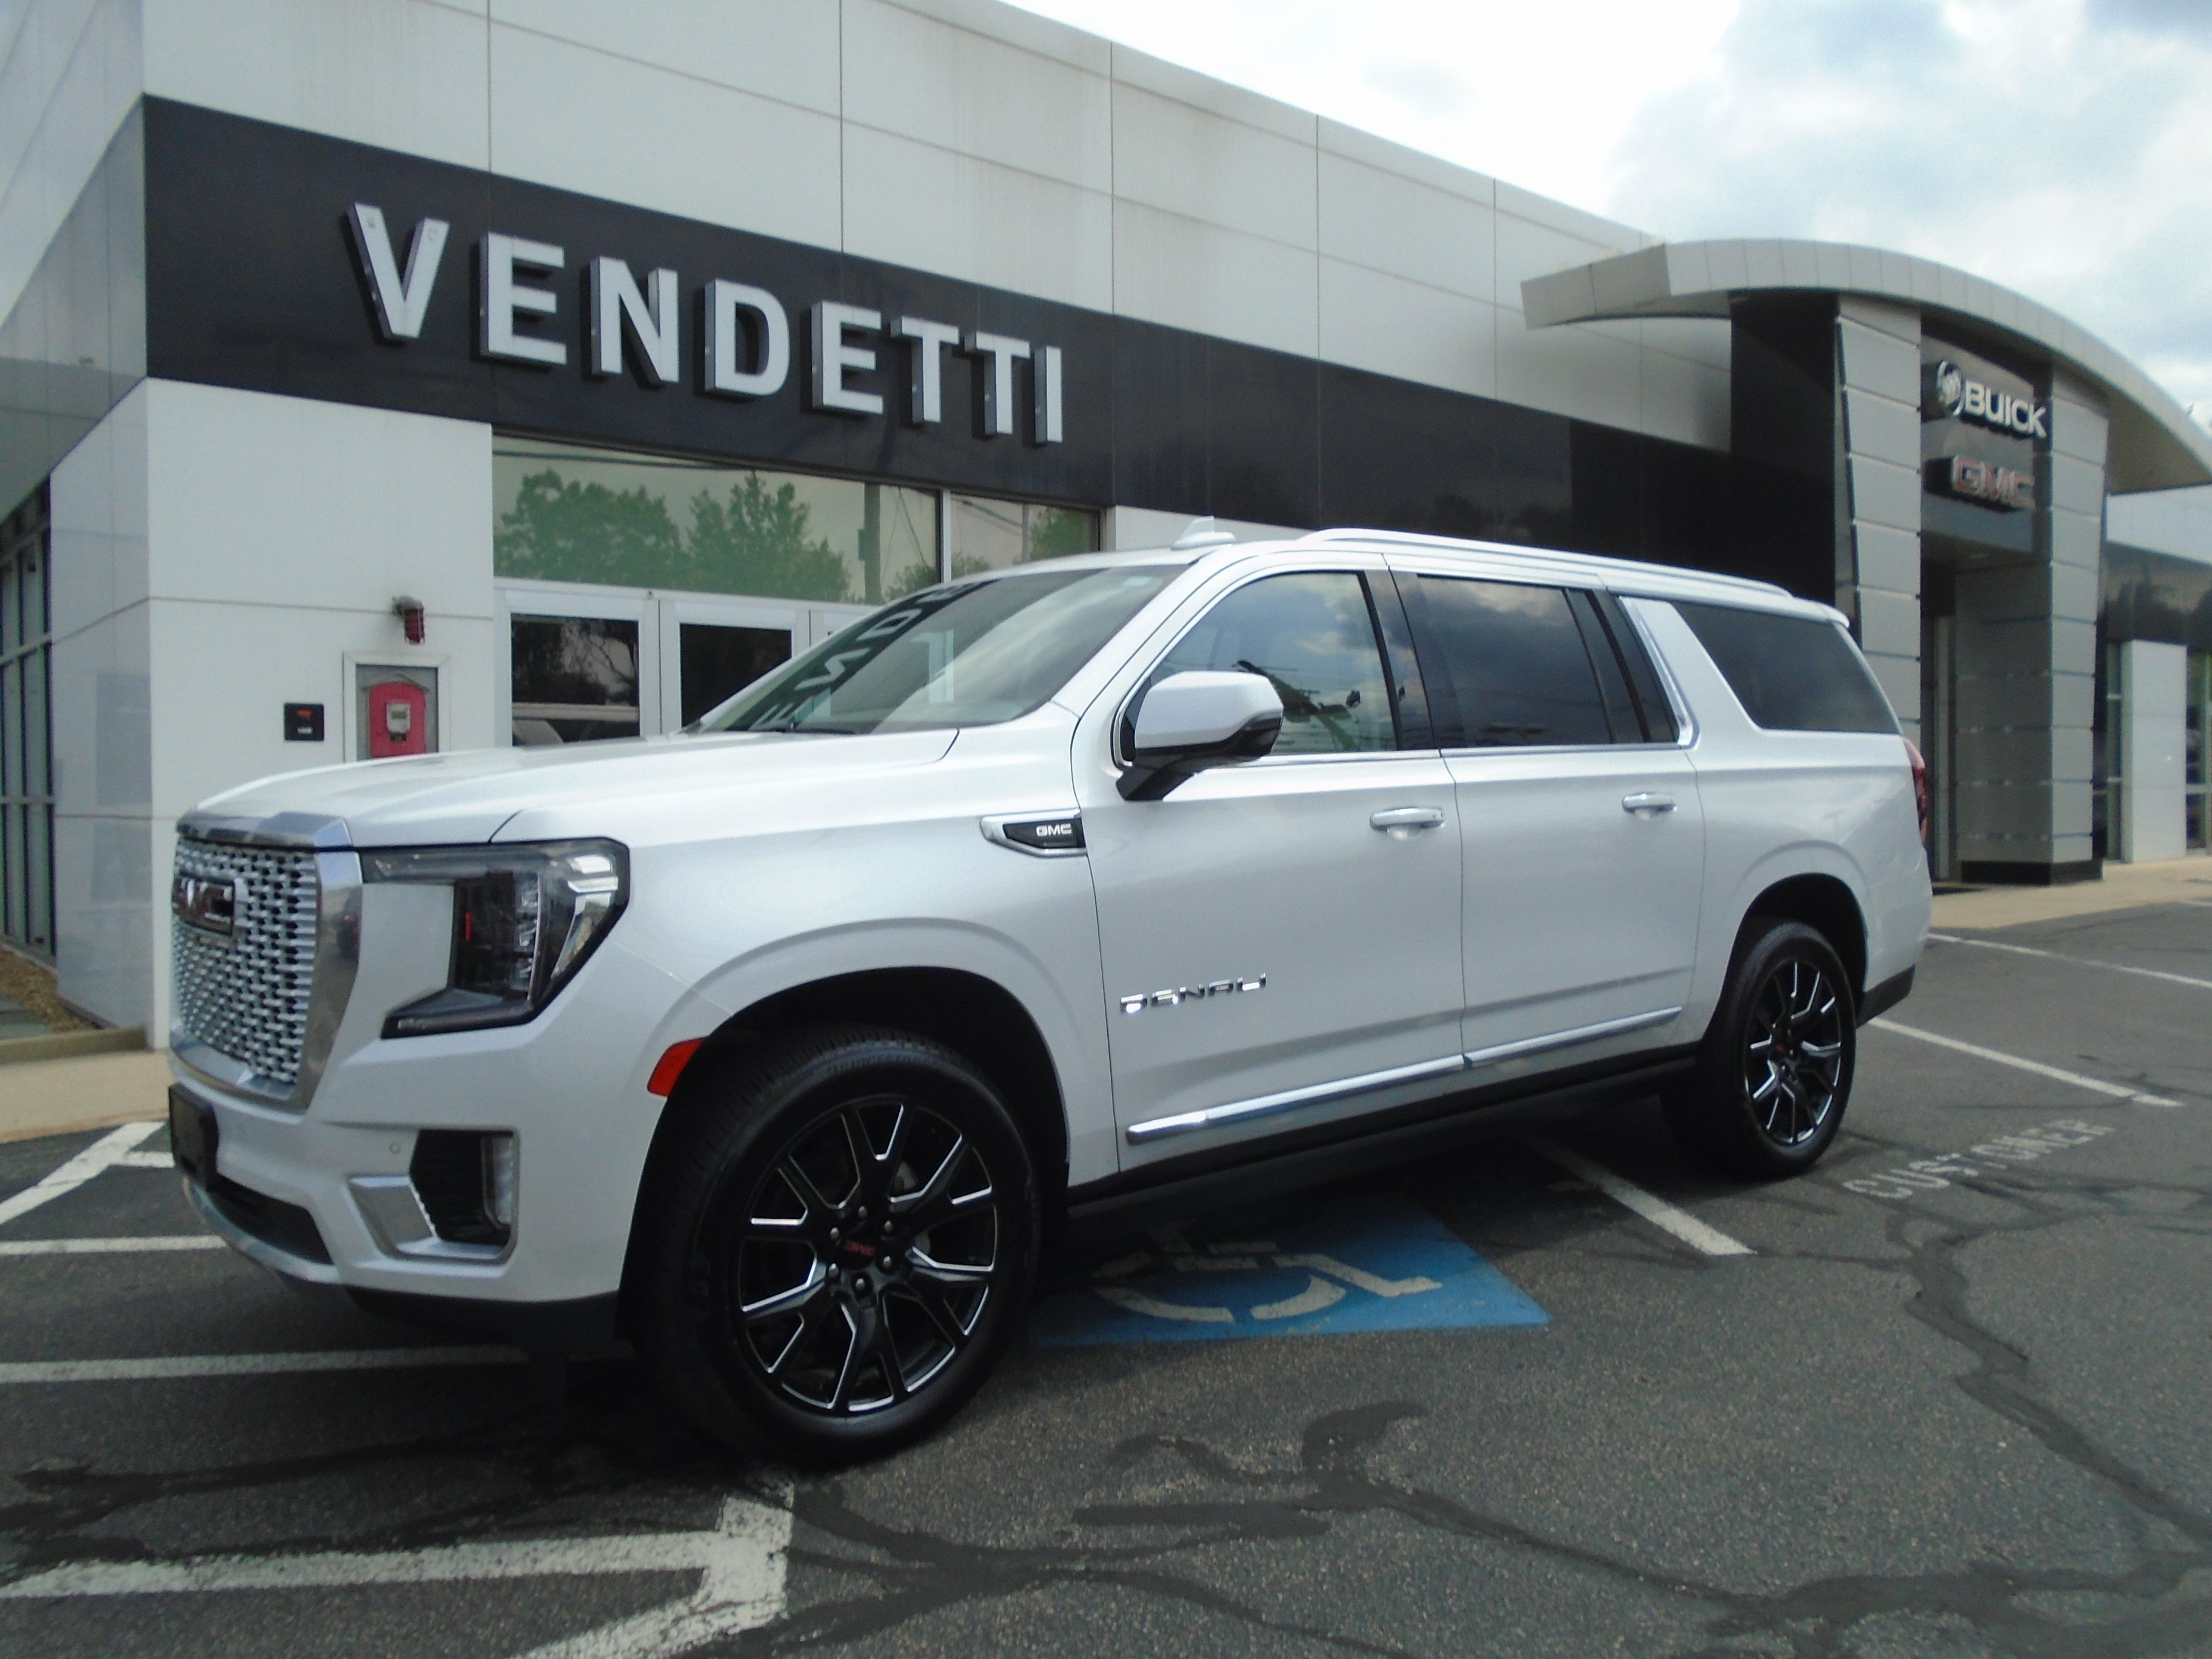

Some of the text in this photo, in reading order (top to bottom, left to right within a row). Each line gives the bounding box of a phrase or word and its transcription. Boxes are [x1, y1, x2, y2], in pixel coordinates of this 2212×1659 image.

[352, 202, 1062, 444] VENDETTI
[1965, 380, 2047, 438] BUICK
[1952, 455, 2036, 508] GMC
[1036, 823, 1072, 837] GMC
[1120, 973, 1266, 1013] DENALI
[1843, 1119, 2116, 1199] CUSTOMER
